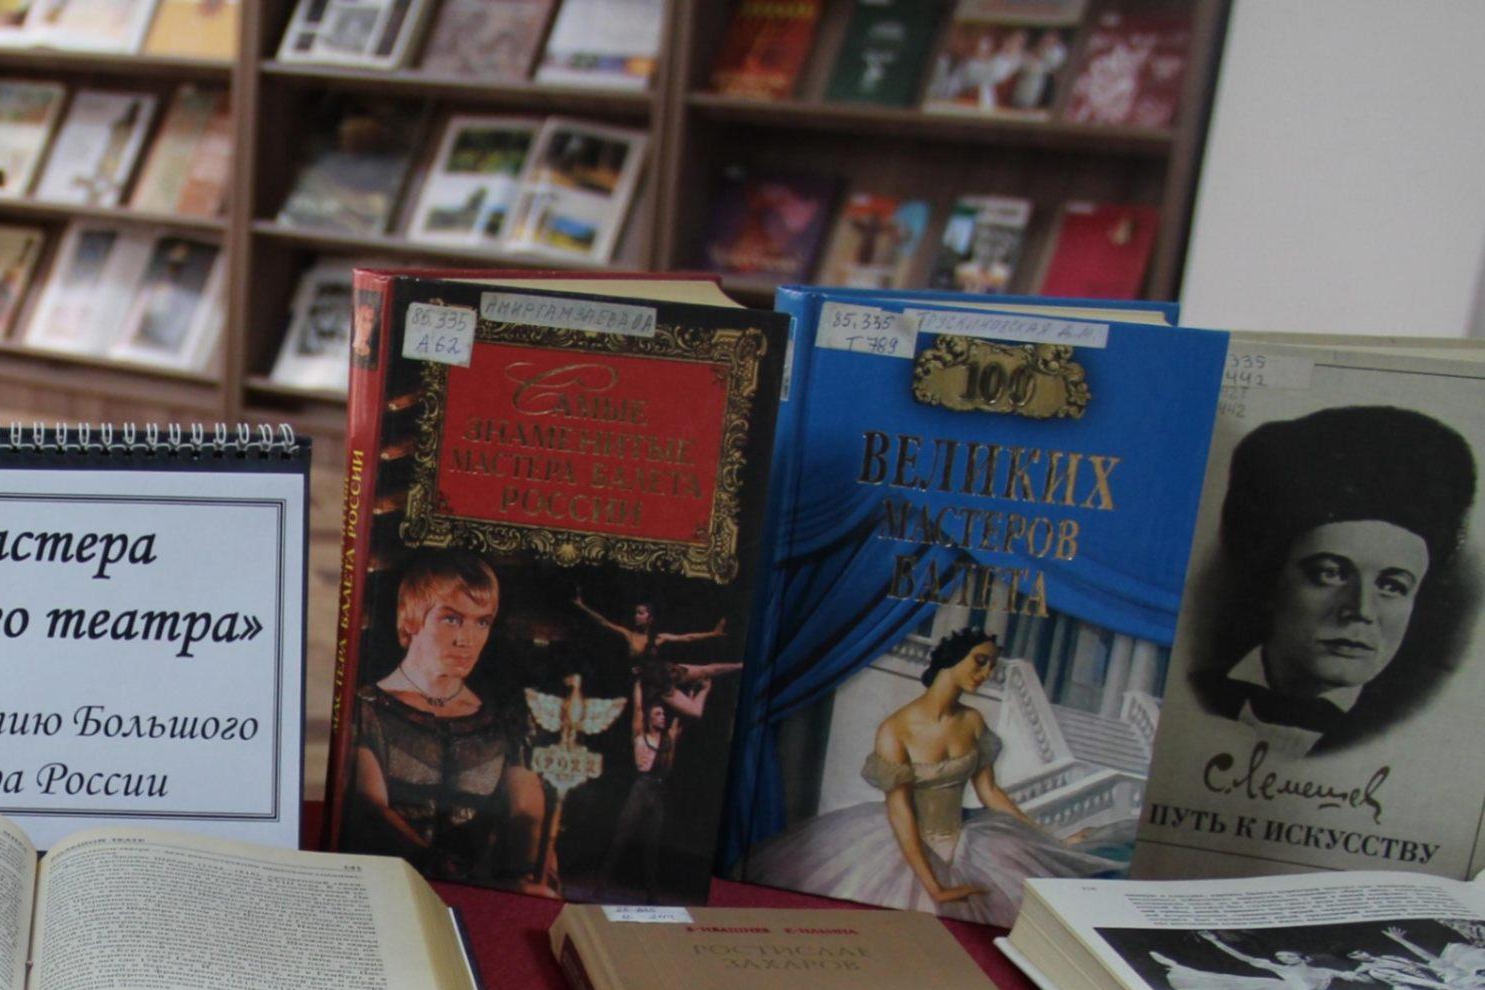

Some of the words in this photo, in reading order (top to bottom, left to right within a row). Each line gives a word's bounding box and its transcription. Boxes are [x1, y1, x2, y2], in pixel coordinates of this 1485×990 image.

[961, 361, 1034, 406] 100
[462, 418, 695, 466] ЗНАМЕНИТЫЕ
[347, 450, 364, 538] РОССИИ
[449, 447, 576, 487] МАСТЕРА
[590, 463, 703, 499] БАЛЕТА
[856, 430, 1120, 512] ВЕЛИКИХ
[499, 486, 642, 528] РОССИИ
[877, 500, 1080, 561] МАСТЕРОВ
[340, 548, 356, 629] БАЛЕТА
[887, 553, 1049, 618] БАЛЕТА
[46, 609, 263, 656] театра»
[73, 705, 258, 742] Большого
[36, 763, 169, 798] России
[1148, 803, 1227, 833] ПУТЬ
[1235, 809, 1258, 839] К
[1264, 811, 1441, 866] ИСКУССТВУ
